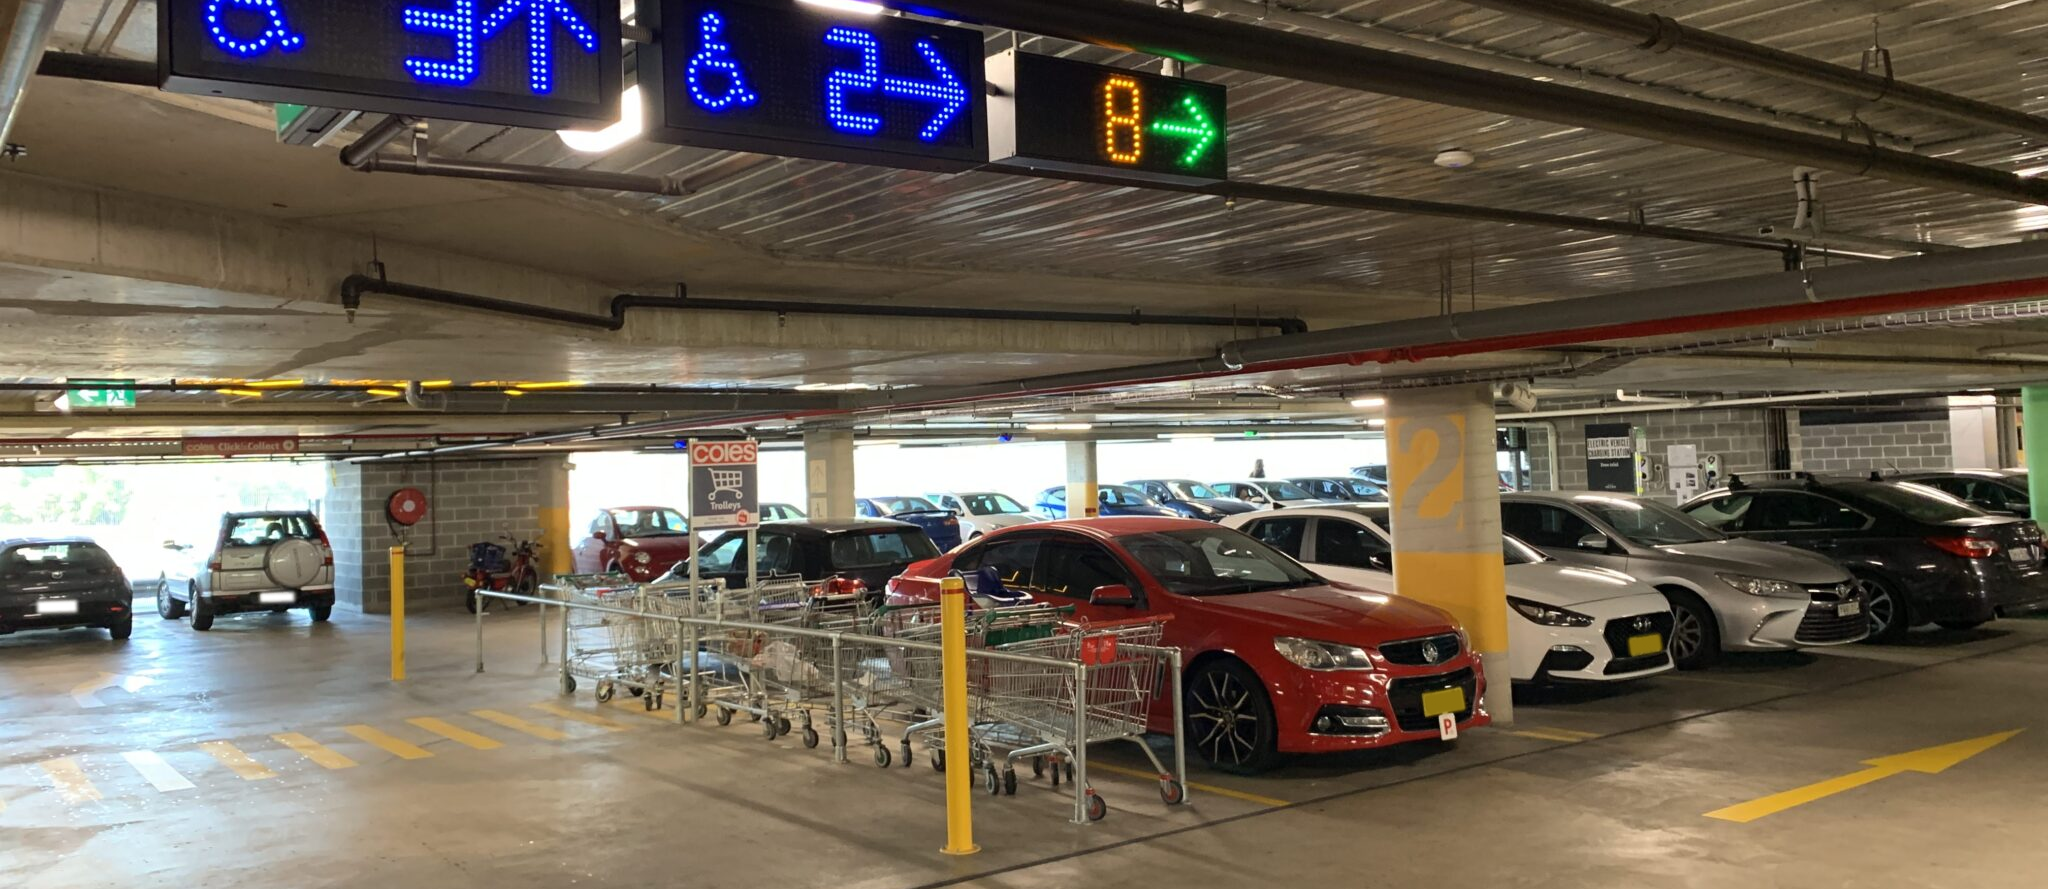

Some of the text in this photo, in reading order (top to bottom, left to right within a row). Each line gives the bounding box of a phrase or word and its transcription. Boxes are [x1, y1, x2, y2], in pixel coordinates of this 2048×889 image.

[826, 27, 880, 130] 2
[1104, 77, 1142, 164] 8
[1588, 438, 1630, 448] ELECTRIC VEHICLE
[693, 443, 756, 463] coles
[1588, 447, 1631, 458] CHARGING STATION
[1398, 416, 1463, 531] 2
[710, 501, 741, 511] Trolleys
[1443, 718, 1452, 735] P
